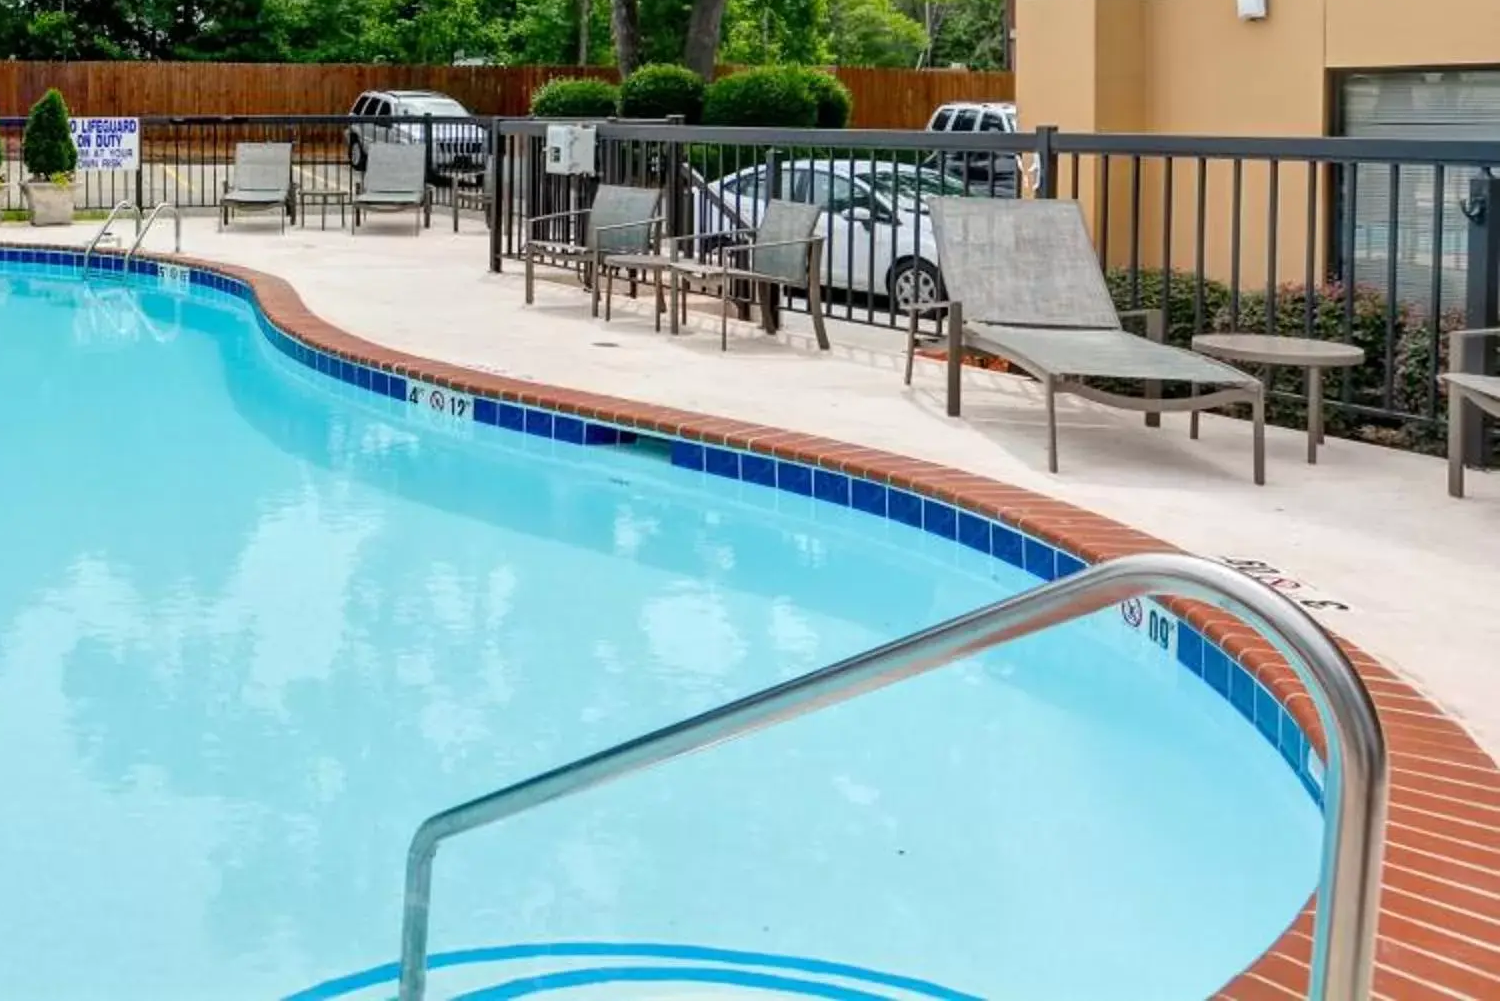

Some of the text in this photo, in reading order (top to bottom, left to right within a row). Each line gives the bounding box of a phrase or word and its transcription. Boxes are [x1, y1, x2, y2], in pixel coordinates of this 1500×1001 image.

[81, 119, 137, 133] LIFEGUARD
[77, 134, 122, 147] ON DUTY
